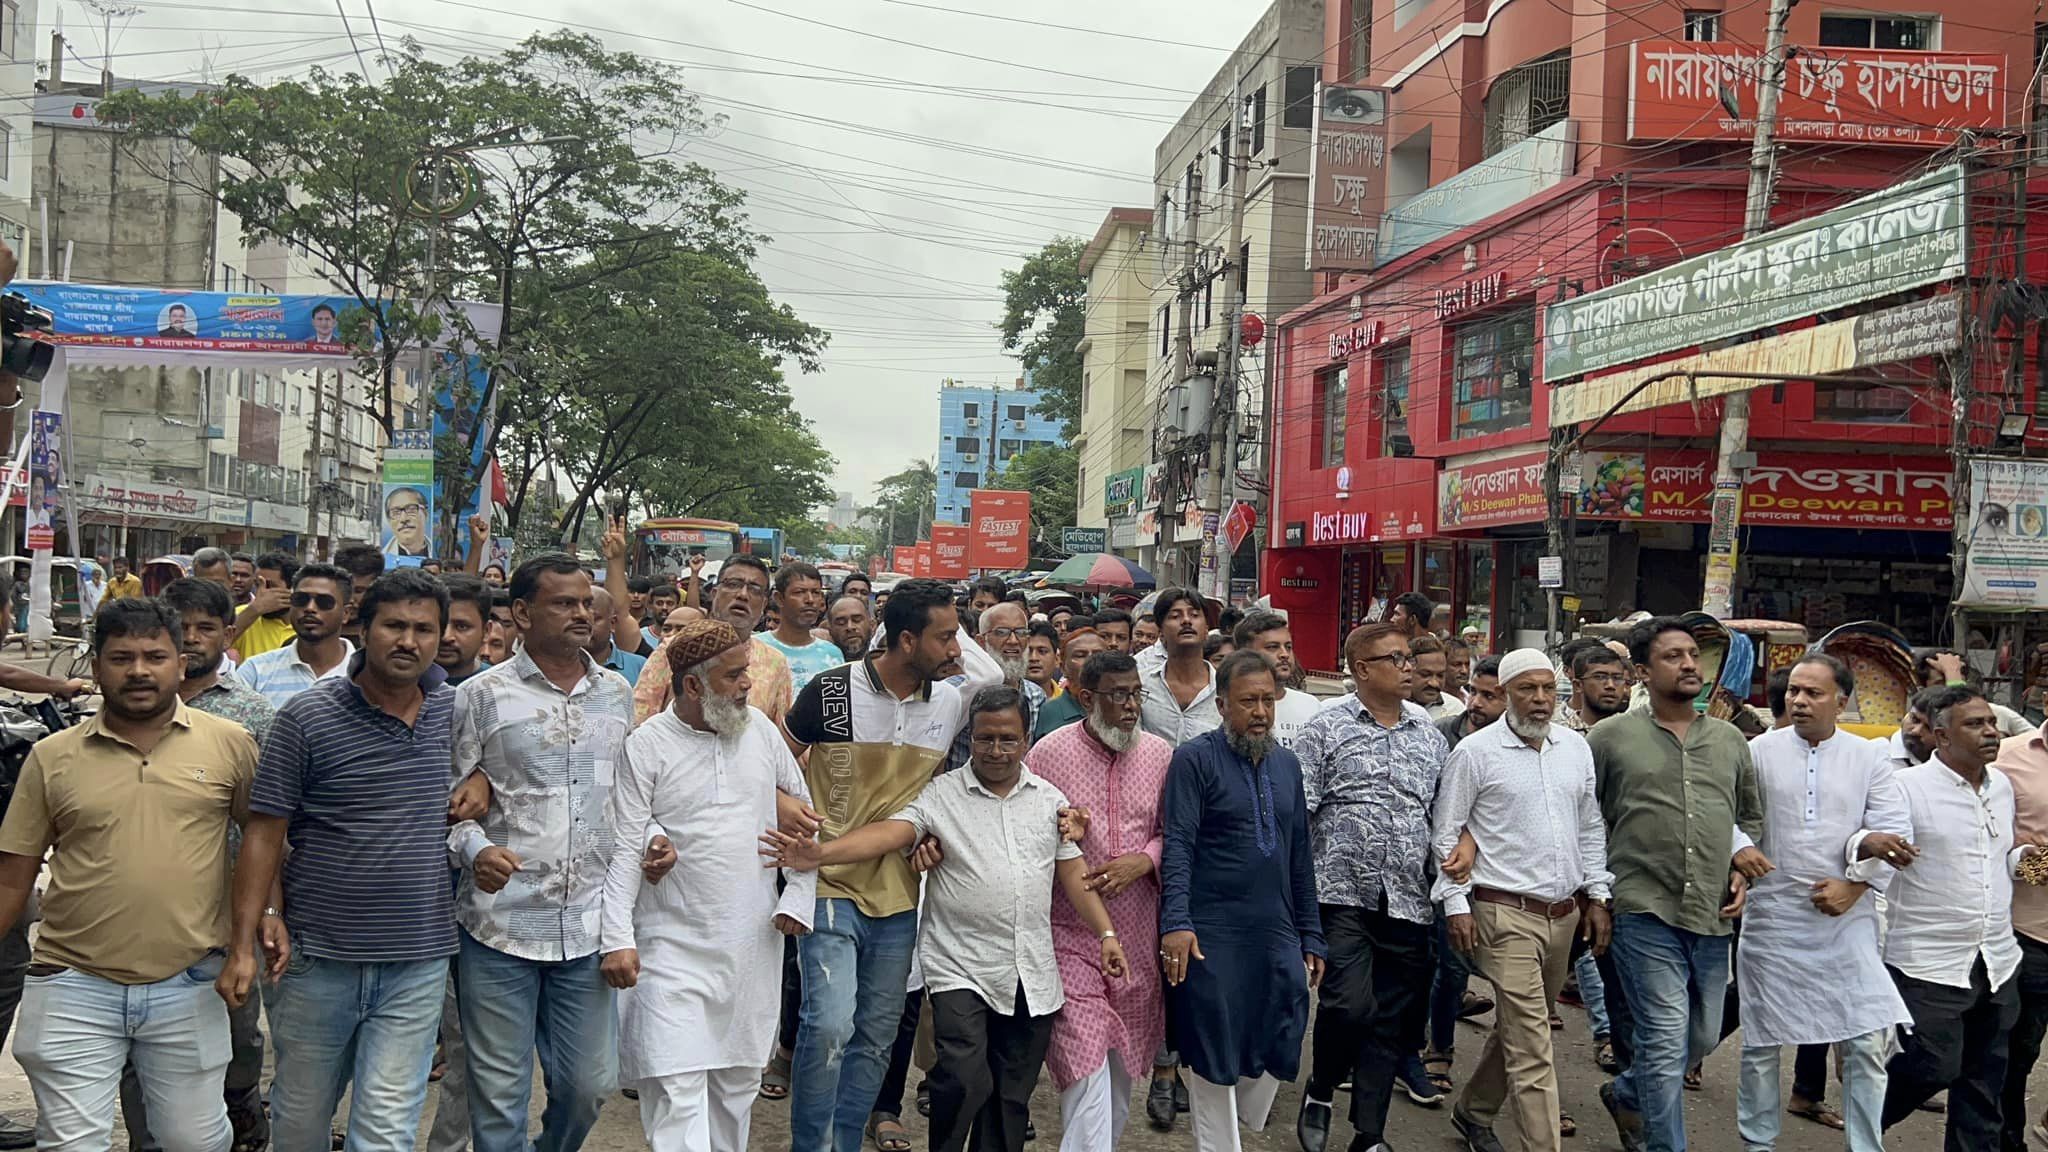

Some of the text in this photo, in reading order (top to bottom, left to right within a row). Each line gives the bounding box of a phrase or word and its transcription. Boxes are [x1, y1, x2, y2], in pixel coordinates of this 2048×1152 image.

[1796, 57, 1849, 120] চক্ষু
[1854, 55, 1999, 114] হাসপাতাল
[1320, 130, 1383, 168] নারায়ণগঞ্জ
[1332, 174, 1368, 220] চক্ষু
[1316, 221, 1378, 263] হাসপাতাল
[1573, 275, 1688, 340] নারায়ণগঞ্জ
[1692, 246, 1766, 302] গার্লস
[1766, 231, 1819, 287] স্কুল
[1833, 183, 1957, 258] কলেজ
[1435, 272, 1502, 319] Best BUY
[1472, 466, 1520, 496] দেওয়ান
[1651, 461, 1706, 485] মেসার্স
[1462, 499, 1480, 514] M/S
[1481, 496, 1516, 511] Deewan
[1653, 491, 1713, 508] M/
[1750, 494, 1903, 512] Deewan
[1064, 528, 1104, 543] মেডিহোপ
[1313, 510, 1341, 542] Best
[1343, 511, 1368, 539] BUY
[1931, 517, 1953, 527] খুচ
